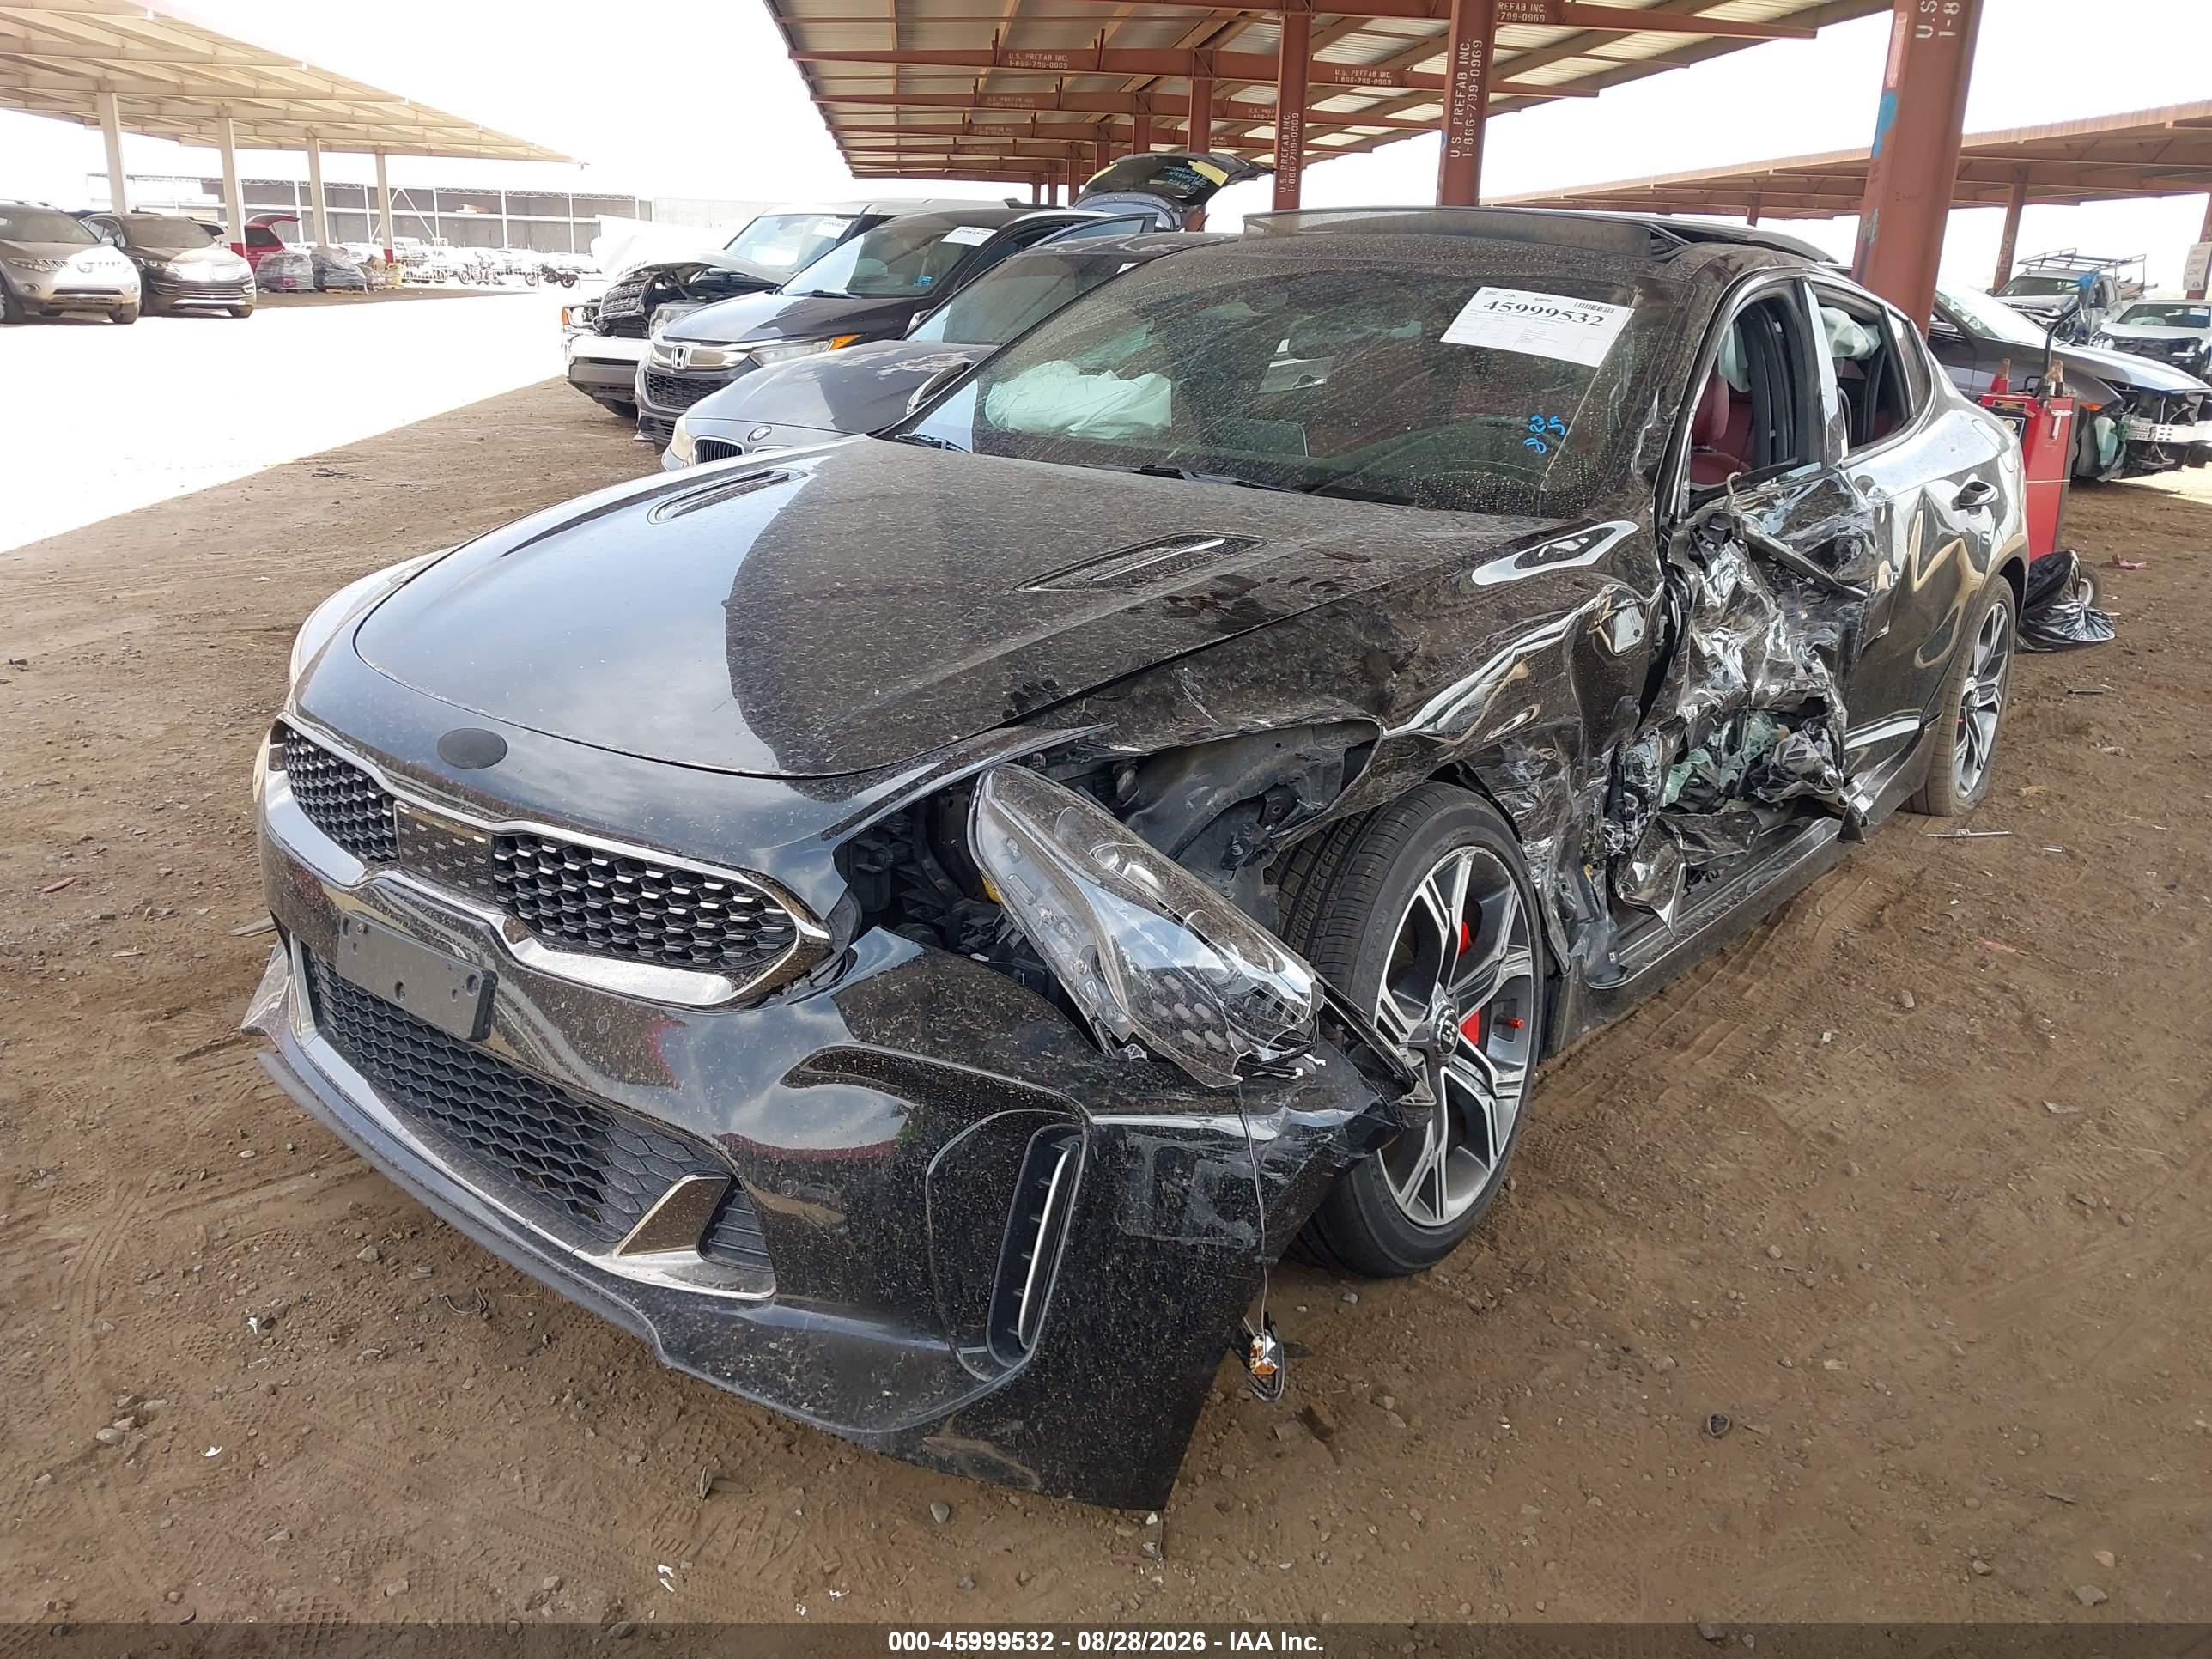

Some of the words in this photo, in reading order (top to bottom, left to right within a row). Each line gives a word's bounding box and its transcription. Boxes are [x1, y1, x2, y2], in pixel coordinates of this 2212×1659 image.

[1497, 11, 1546, 22] -799-0969
[1498, 2, 1526, 12] REFAB
[1530, 3, 1547, 13] INC.
[1458, 39, 1471, 64] INC.
[1453, 71, 1468, 125] PREFAB
[1462, 40, 1483, 156] 1-866-799-0969
[1283, 112, 1291, 130] INC.
[1280, 134, 1290, 171] PREFAB
[1450, 132, 1462, 157] U.S.
[1279, 175, 1288, 193] U.S.
[1483, 300, 1605, 327] 45999532
